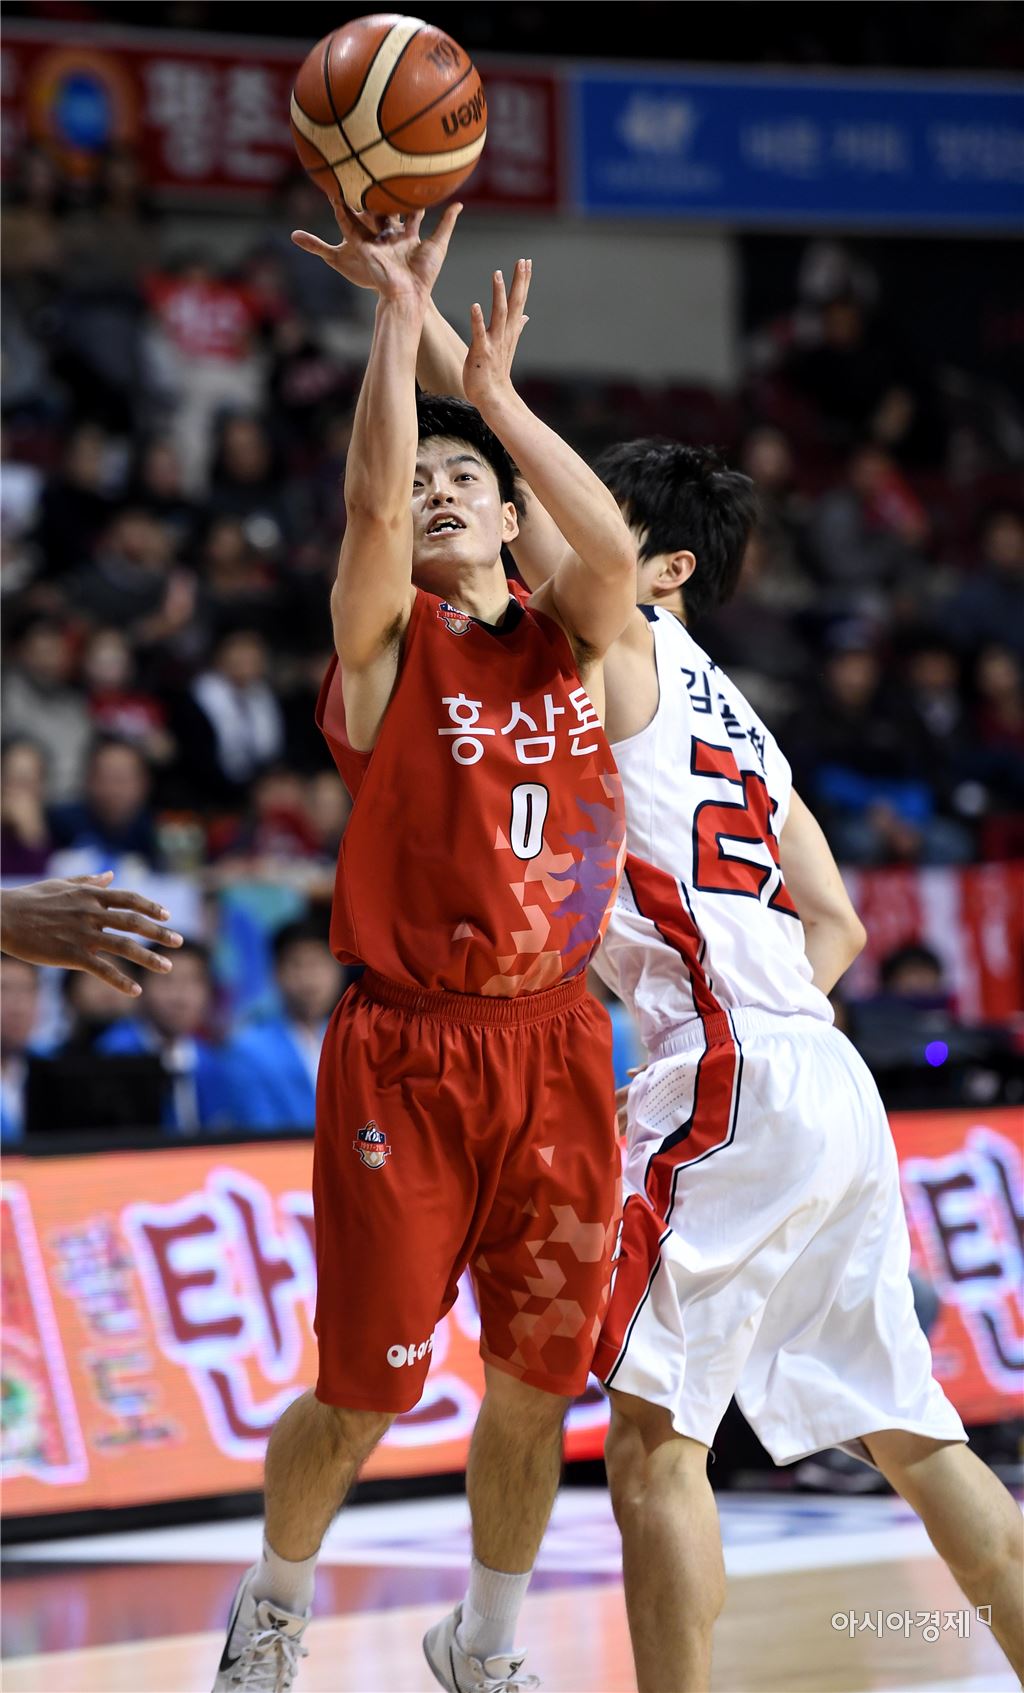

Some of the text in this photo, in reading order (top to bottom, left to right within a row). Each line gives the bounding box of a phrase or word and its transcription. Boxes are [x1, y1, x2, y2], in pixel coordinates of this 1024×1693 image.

[438, 687, 601, 766] 홍삼톤
[509, 782, 549, 860] 0
[690, 735, 800, 920] 2
